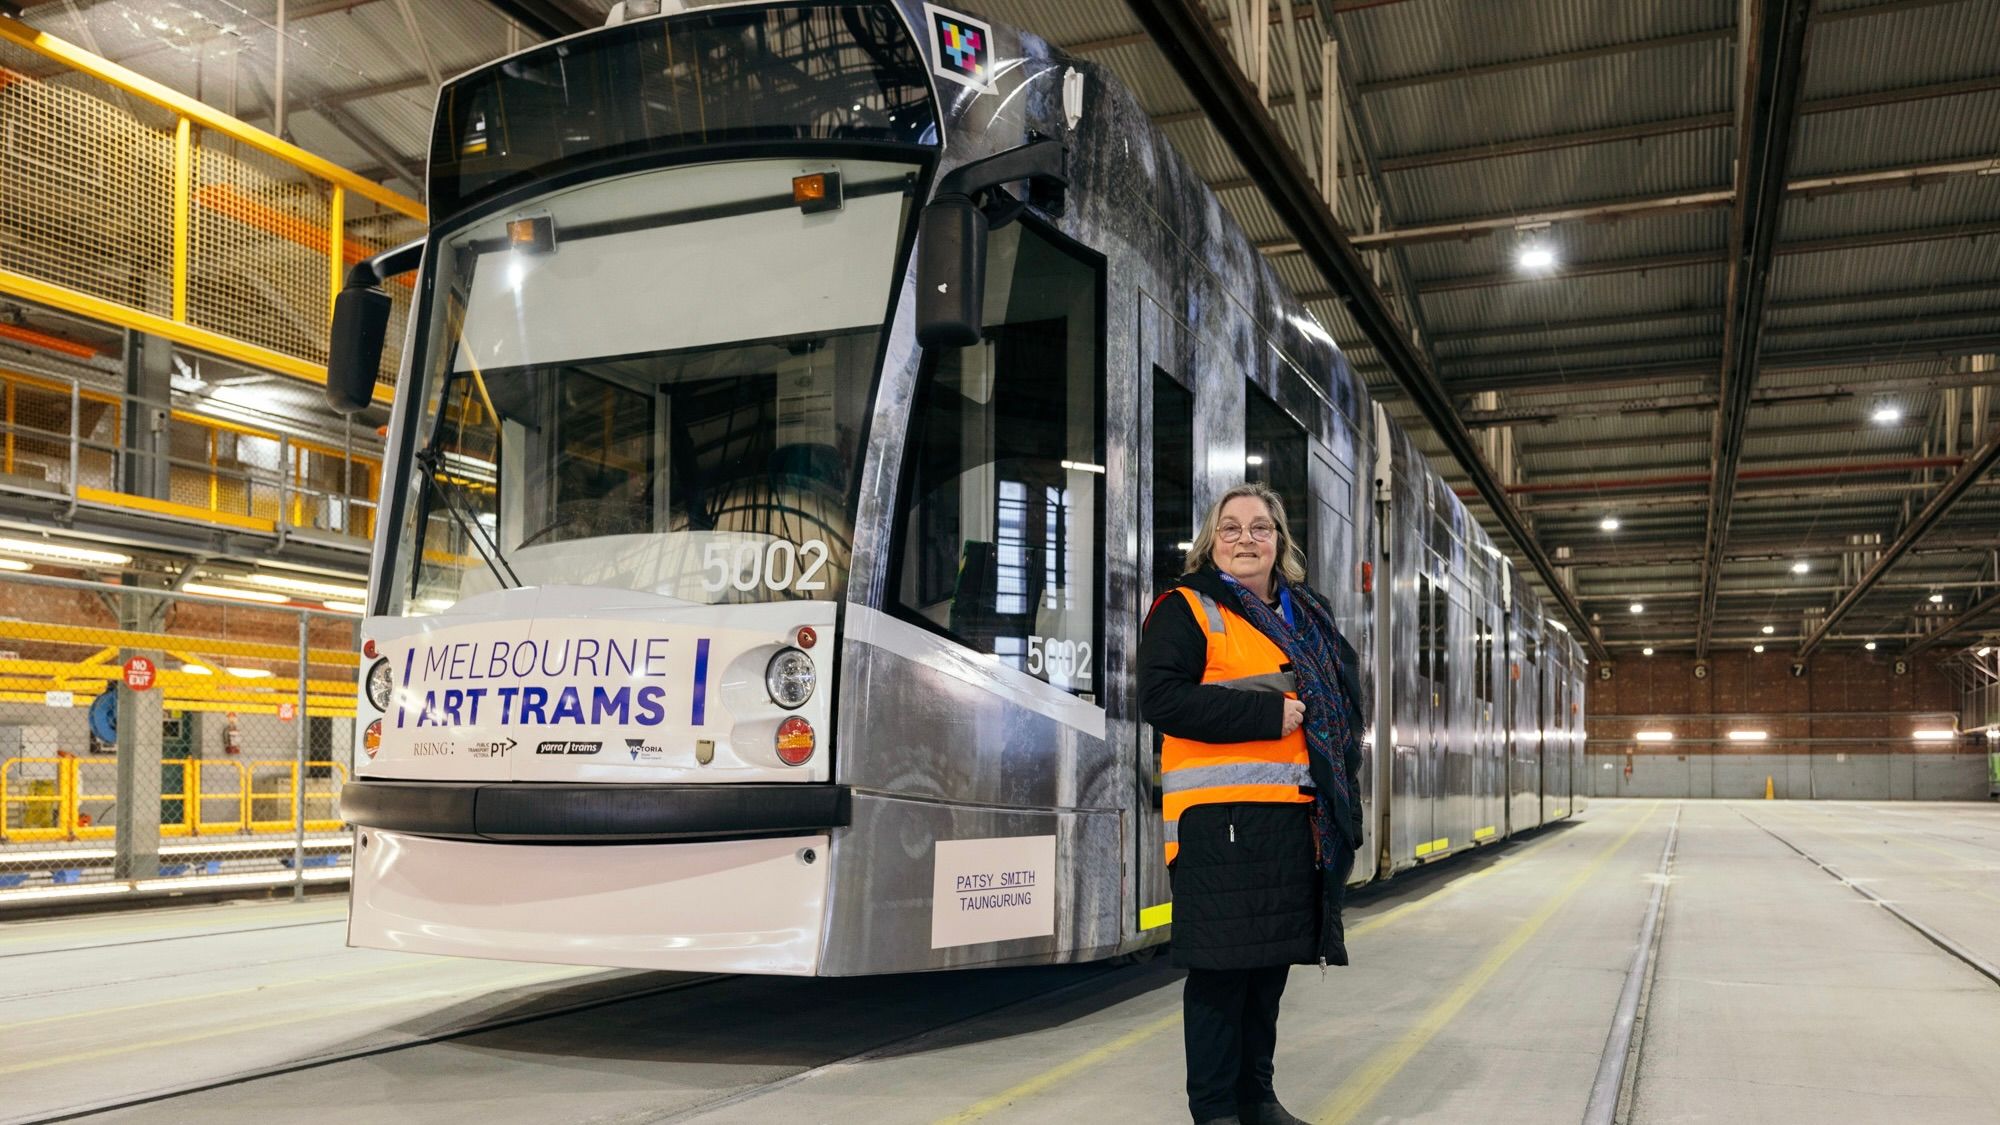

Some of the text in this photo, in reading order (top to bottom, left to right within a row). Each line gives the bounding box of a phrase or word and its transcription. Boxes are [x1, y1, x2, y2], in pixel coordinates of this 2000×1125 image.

[702, 539, 829, 592] 5002
[132, 659, 147, 671] NO
[424, 638, 669, 682] MELBOURNE
[1027, 635, 1092, 679] 5002
[1601, 667, 1611, 680] 5
[1694, 665, 1706, 678] 6
[1793, 663, 1804, 677] 7
[1895, 661, 1906, 675] 8
[416, 685, 666, 728] ART TRAMS
[540, 743, 598, 753] yarra trams
[956, 870, 1035, 890] PATSY SMITH
[960, 891, 1032, 912] TAUNGURUNG
